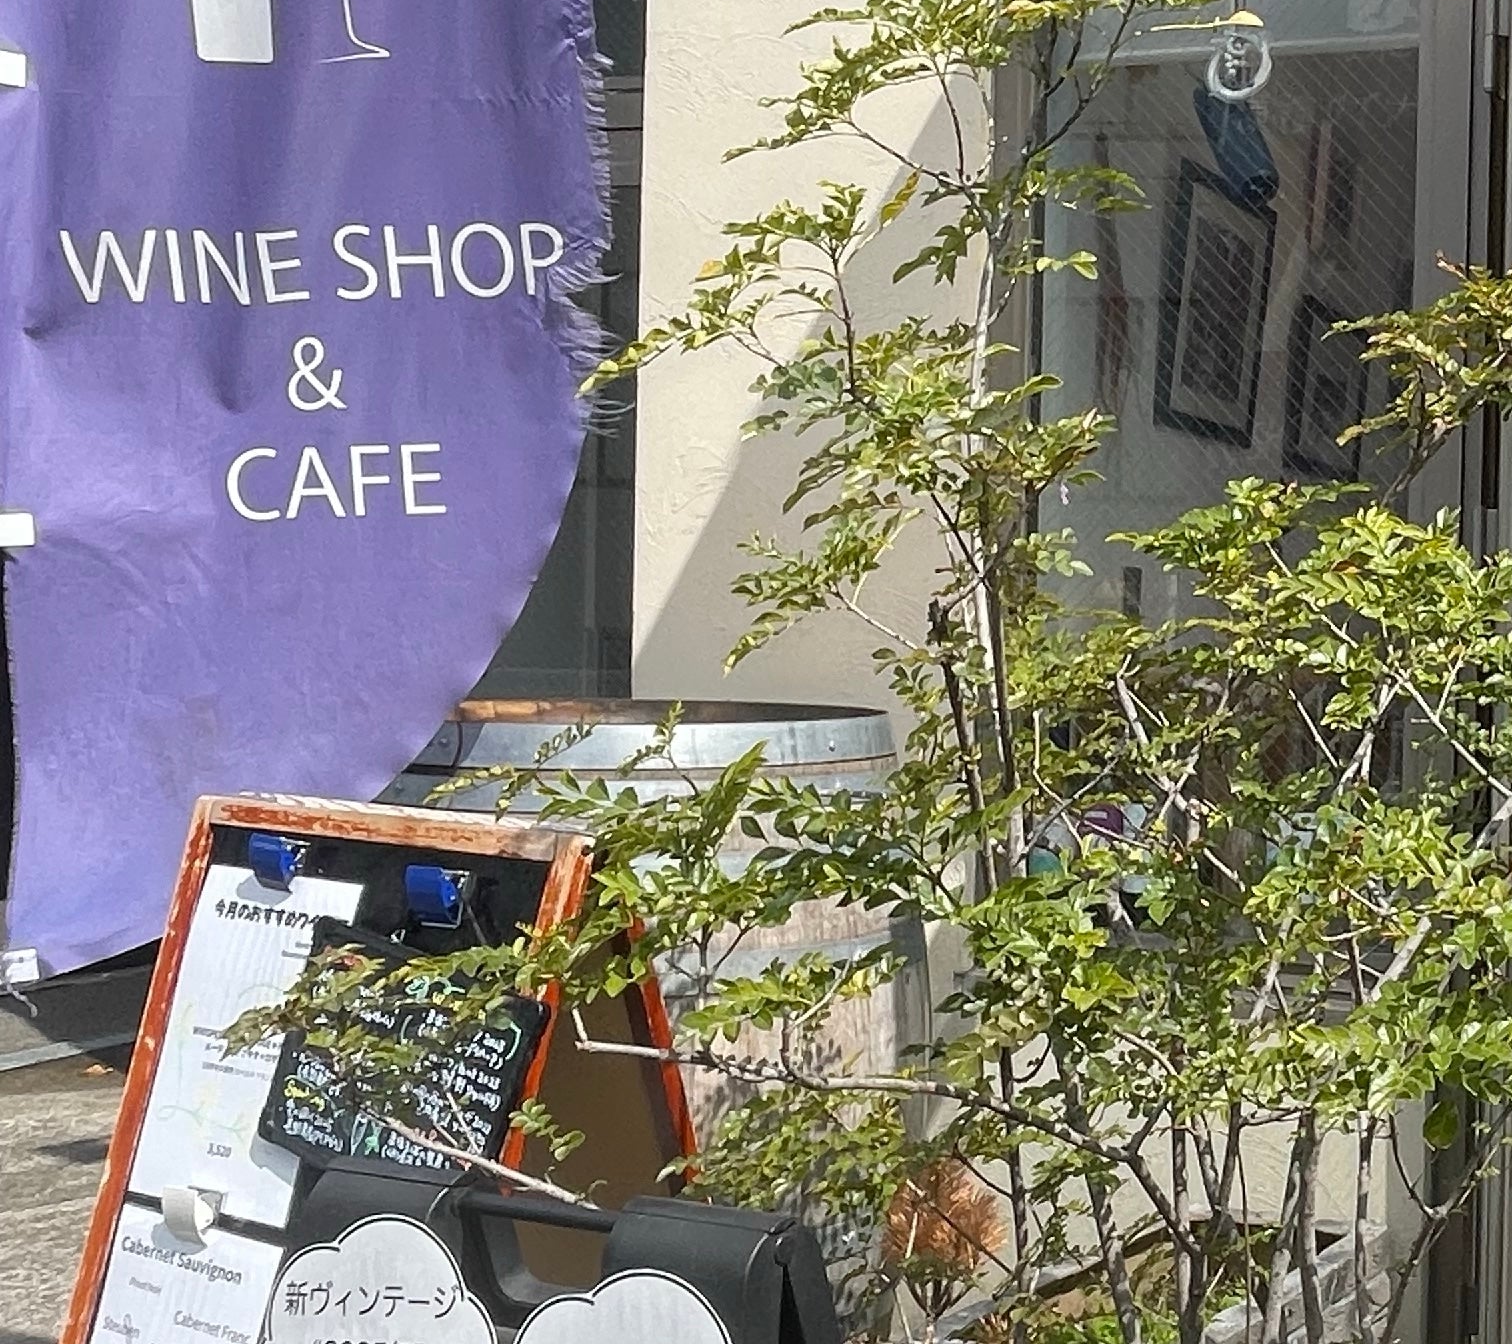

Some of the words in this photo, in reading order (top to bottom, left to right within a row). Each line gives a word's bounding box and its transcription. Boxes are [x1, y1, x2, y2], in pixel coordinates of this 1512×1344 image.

[60, 229, 310, 306] WINE
[332, 223, 564, 301] SHOP
[287, 336, 348, 412] &
[225, 443, 448, 522] CAFE
[121, 1236, 176, 1266] Cabernet
[176, 1253, 243, 1285] Sauvignon
[283, 1280, 462, 1319] 新ヴィンテージ
